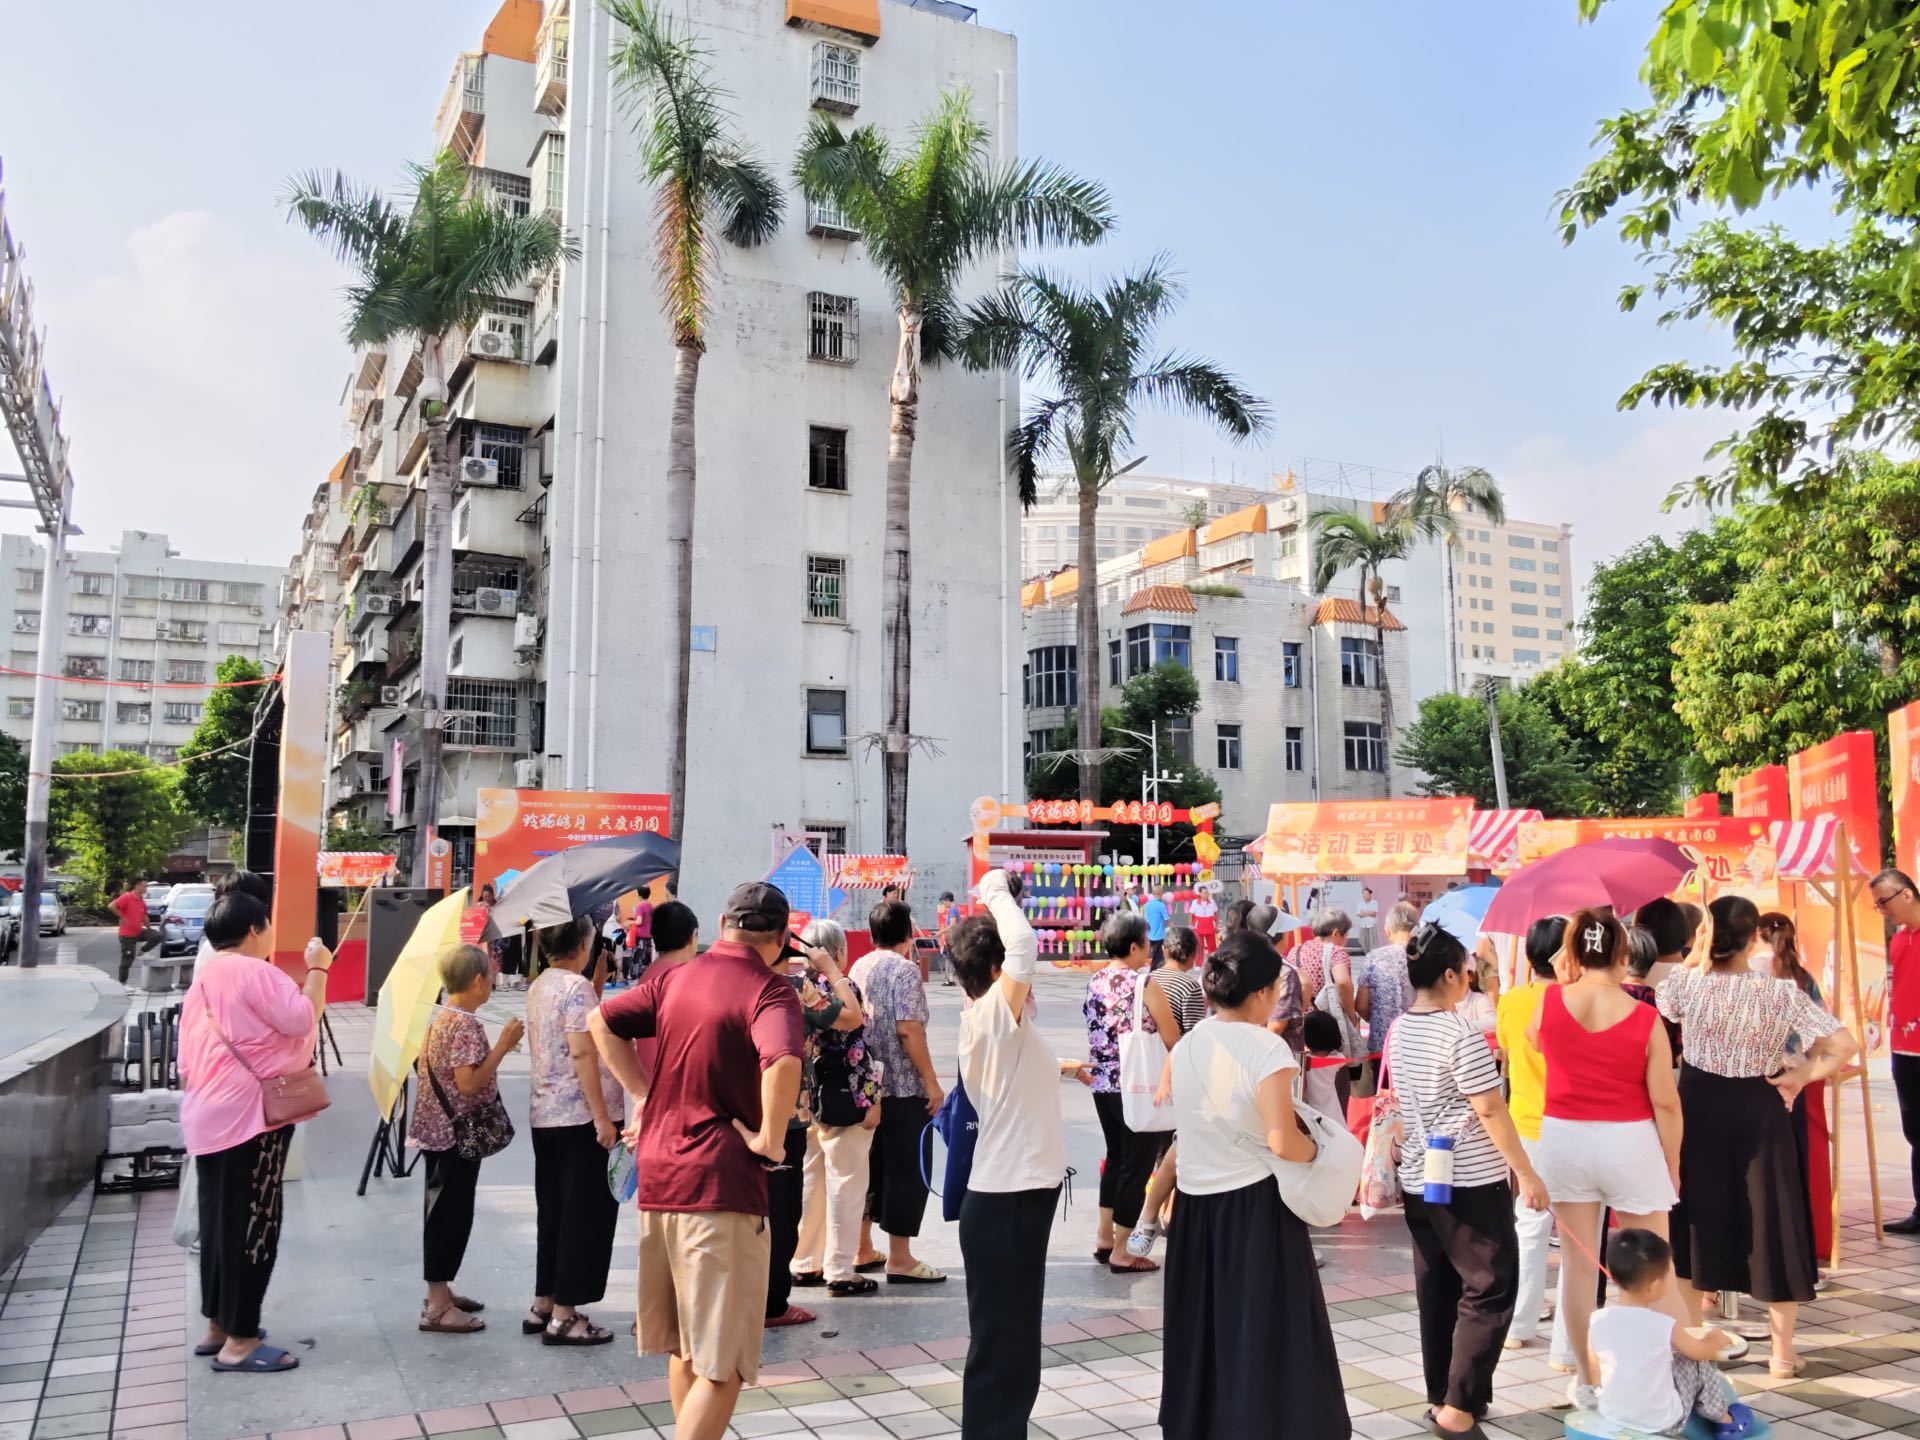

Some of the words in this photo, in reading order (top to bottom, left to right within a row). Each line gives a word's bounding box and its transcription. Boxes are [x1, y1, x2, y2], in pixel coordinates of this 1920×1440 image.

[522, 812, 587, 831] 玲珑皓月
[600, 815, 660, 832] 共度团圆
[1030, 803, 1092, 821] 玲珑皓月
[1113, 803, 1173, 823] 共度团圆
[1300, 831, 1434, 855] 活动签到处
[1704, 854, 1732, 882] 处
